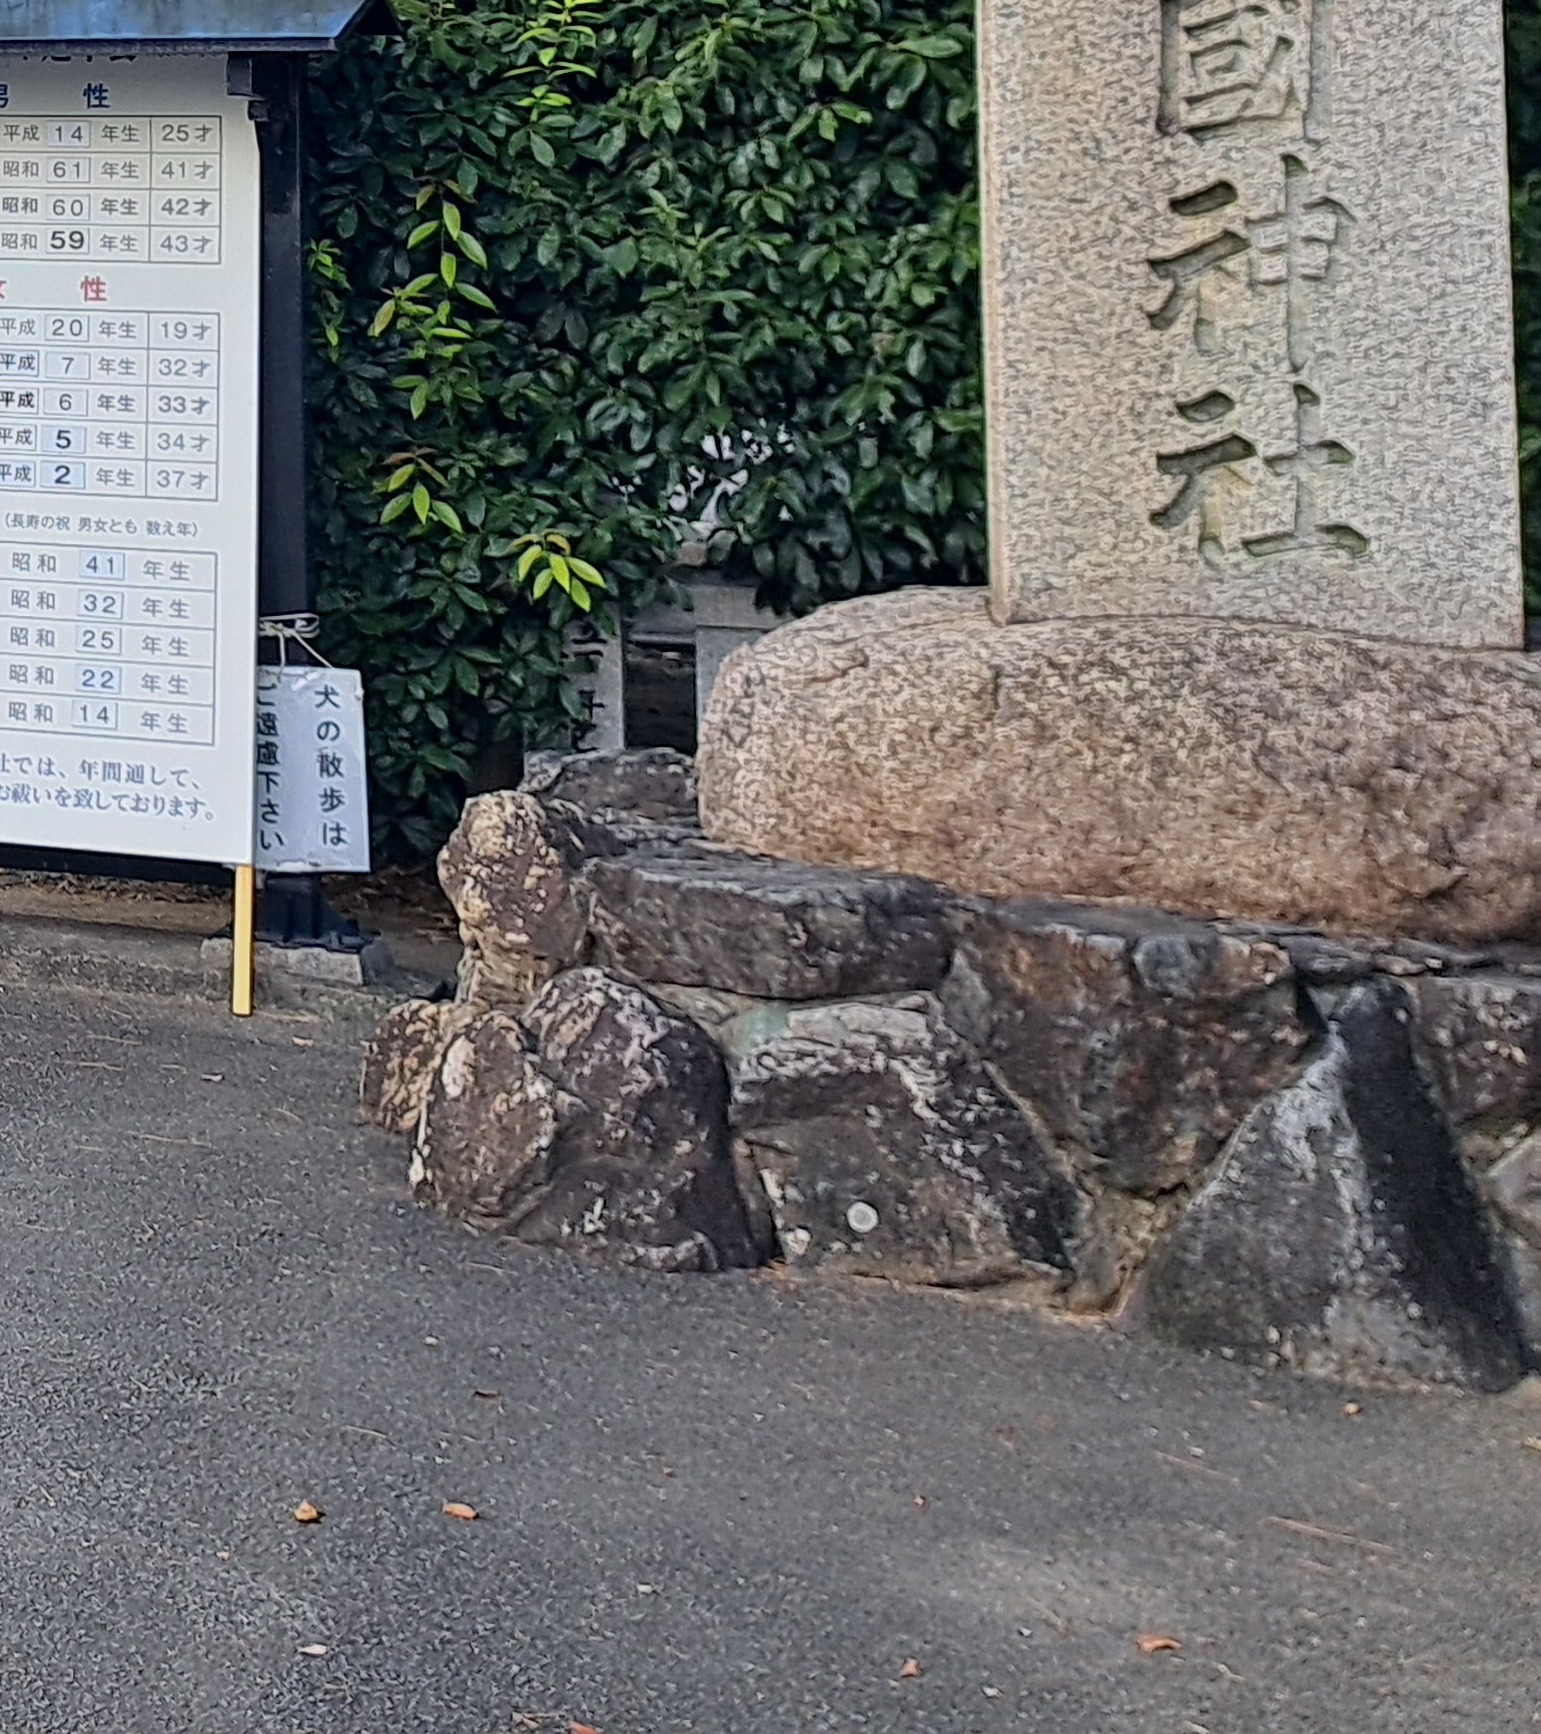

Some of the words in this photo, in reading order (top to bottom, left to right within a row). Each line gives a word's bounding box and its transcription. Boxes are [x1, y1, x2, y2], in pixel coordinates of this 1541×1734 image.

[53, 125, 84, 142] 14
[160, 124, 214, 143] 25才
[52, 161, 81, 179] 61
[160, 160, 213, 180] 41才
[52, 199, 84, 216] 60
[160, 198, 213, 216] 42才
[49, 231, 85, 250] 59
[159, 234, 213, 254] 43才
[51, 319, 84, 336] 20
[160, 321, 212, 340] 19才
[158, 358, 212, 377] 32才
[157, 395, 211, 415] 33才
[156, 433, 210, 452] 34才
[155, 471, 209, 490] 37才
[12, 551, 57, 574] 昭和
[85, 556, 116, 576] 41
[142, 559, 191, 582] 年生
[11, 589, 56, 611] 昭和
[84, 594, 117, 614] 32
[141, 597, 190, 619] 年生
[10, 627, 56, 649] 昭和
[81, 630, 115, 650] 25
[141, 634, 190, 657] 年生
[9, 664, 55, 687] 昭和
[81, 669, 115, 689] 22
[140, 673, 189, 696] 年生
[8, 701, 53, 724] 昭和
[79, 704, 110, 723] 14
[140, 711, 189, 735] 年生
[314, 683, 348, 846] 犬の散歩は
